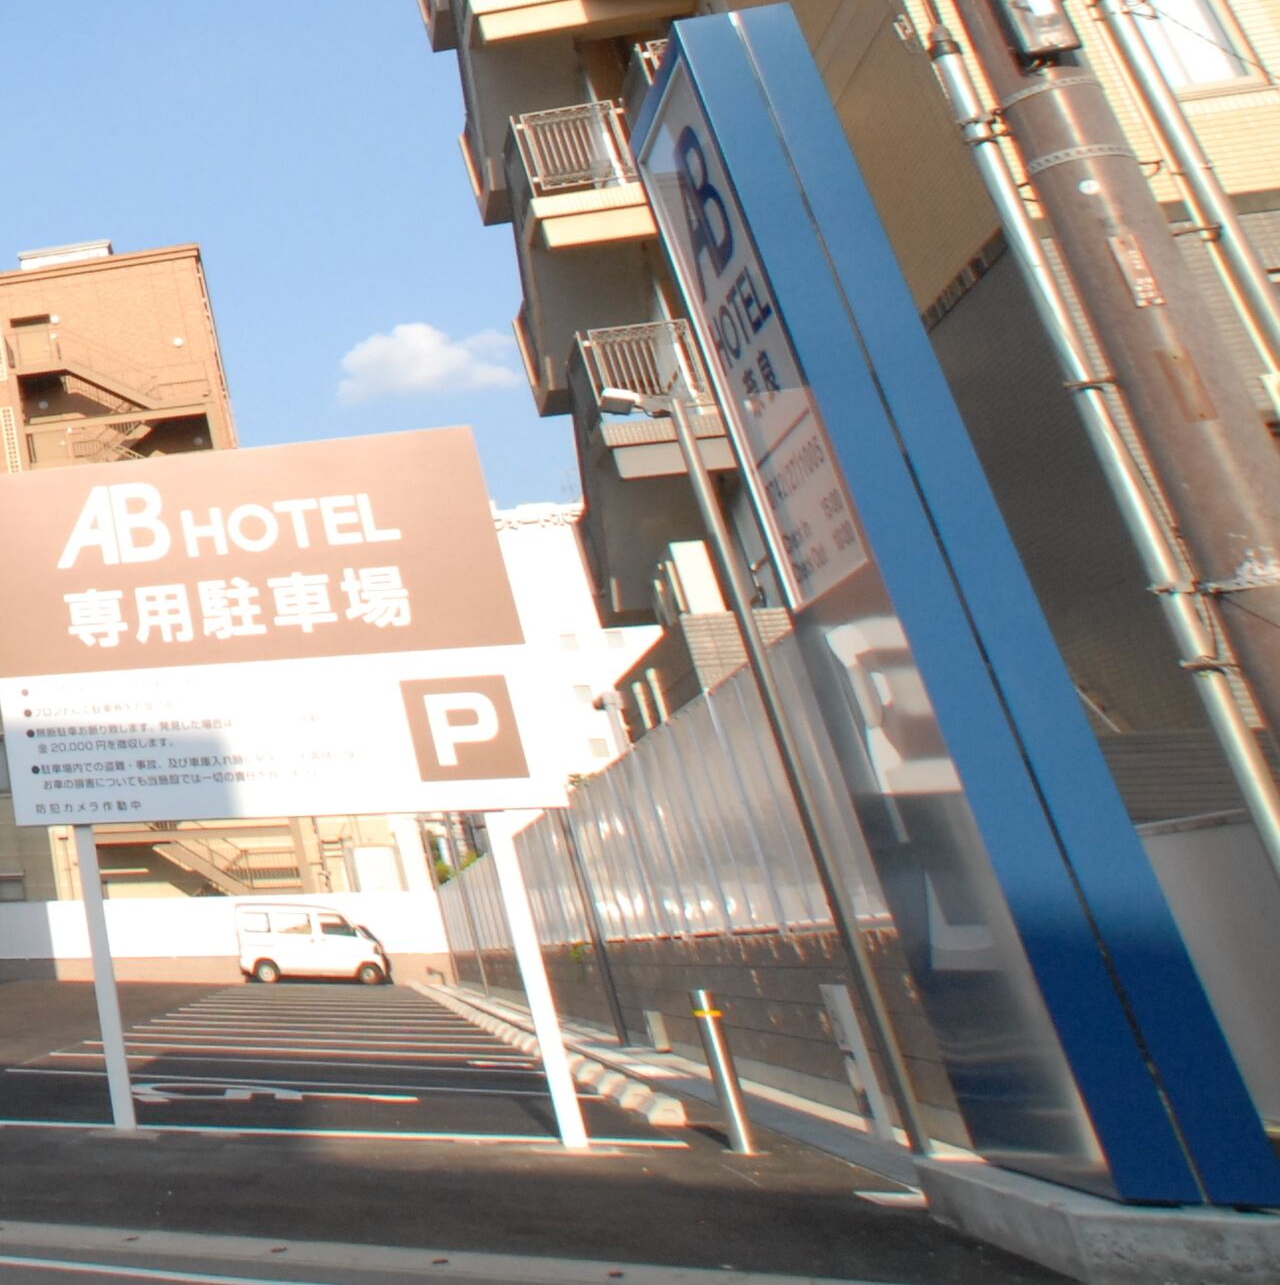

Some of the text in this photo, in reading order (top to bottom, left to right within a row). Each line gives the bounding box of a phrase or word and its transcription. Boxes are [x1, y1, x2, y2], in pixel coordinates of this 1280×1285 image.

[674, 125, 734, 305] AB
[707, 266, 773, 377] HOTEL
[57, 482, 401, 569] AB HOTEL
[63, 566, 412, 648] 専用駐車場
[423, 691, 499, 767] P
[35, 799, 142, 815] 防犯カメラ作動中
